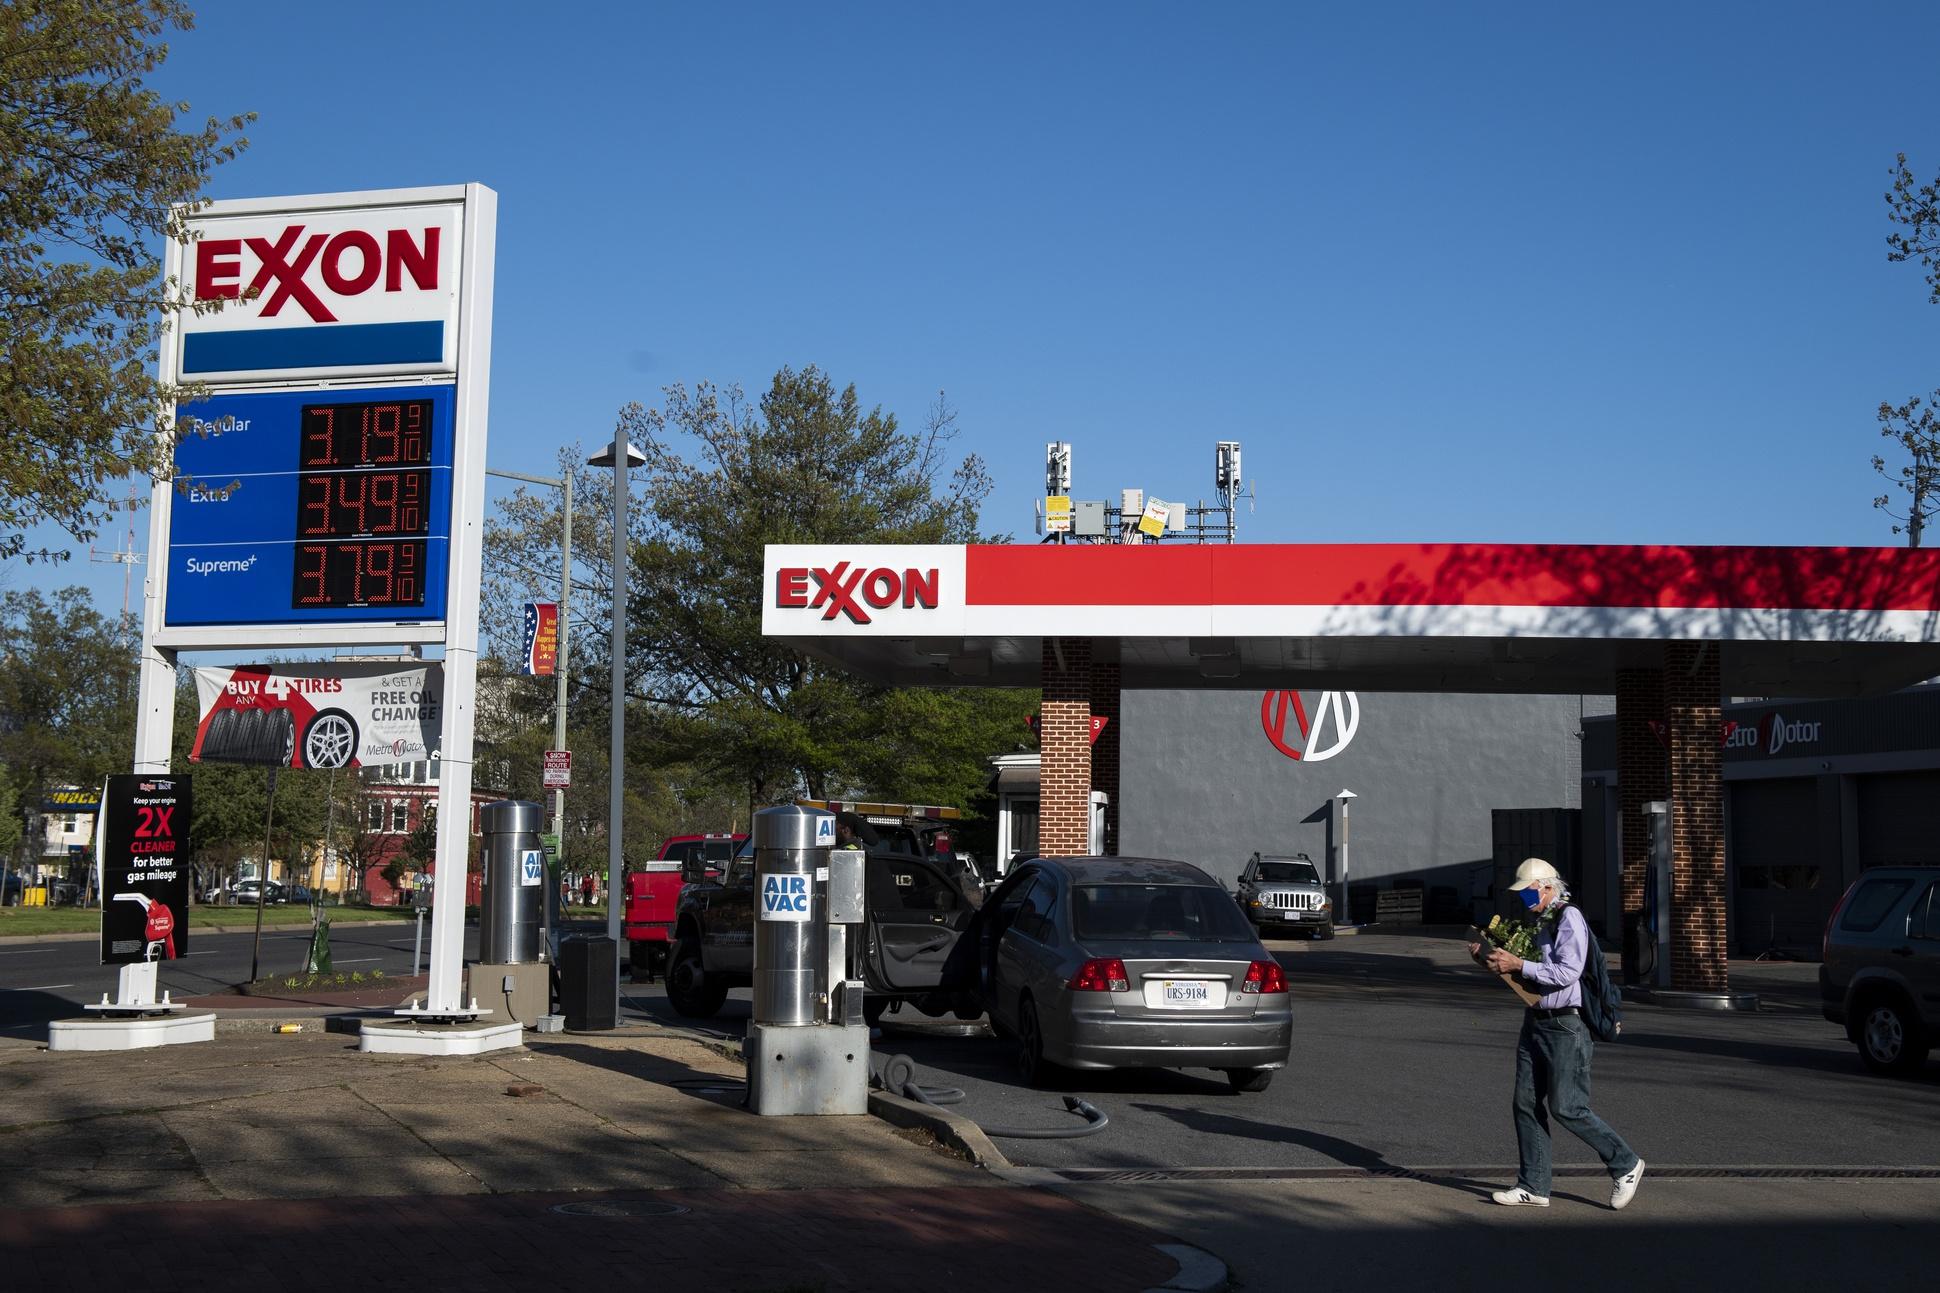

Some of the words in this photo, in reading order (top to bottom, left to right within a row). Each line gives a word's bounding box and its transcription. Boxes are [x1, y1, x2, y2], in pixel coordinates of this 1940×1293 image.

[195, 225, 441, 323] EXXON
[194, 416, 251, 437] Regular
[308, 406, 400, 465] 3.19
[190, 488, 229, 503] Extra
[305, 475, 399, 534] 3.49
[186, 554, 257, 577] Supreme+
[301, 544, 395, 603] 3.79
[777, 561, 939, 624] EXXON
[226, 680, 261, 695] BUY
[264, 675, 290, 701] 4
[294, 678, 342, 694] TIRES
[381, 678, 390, 687] &
[392, 677, 413, 687] GET
[415, 677, 423, 687] A
[235, 696, 256, 704] ANY
[372, 691, 407, 705] FREE
[410, 691, 437, 704] OIL
[1093, 720, 1100, 729] 3
[1658, 724, 1666, 734] 2
[1721, 726, 1728, 736] 1
[1726, 725, 1757, 748] etro
[133, 797, 149, 805] Keep
[161, 797, 176, 806] engine
[134, 807, 174, 838] 2X
[130, 841, 176, 853] CLEANER
[133, 856, 148, 868] for
[149, 855, 173, 867] better
[525, 852, 543, 865] AI
[127, 872, 145, 884] gas
[147, 869, 177, 882] mileage
[764, 876, 806, 894] AIR
[763, 894, 807, 912] VAC
[1167, 988, 1207, 999] URS-9184
